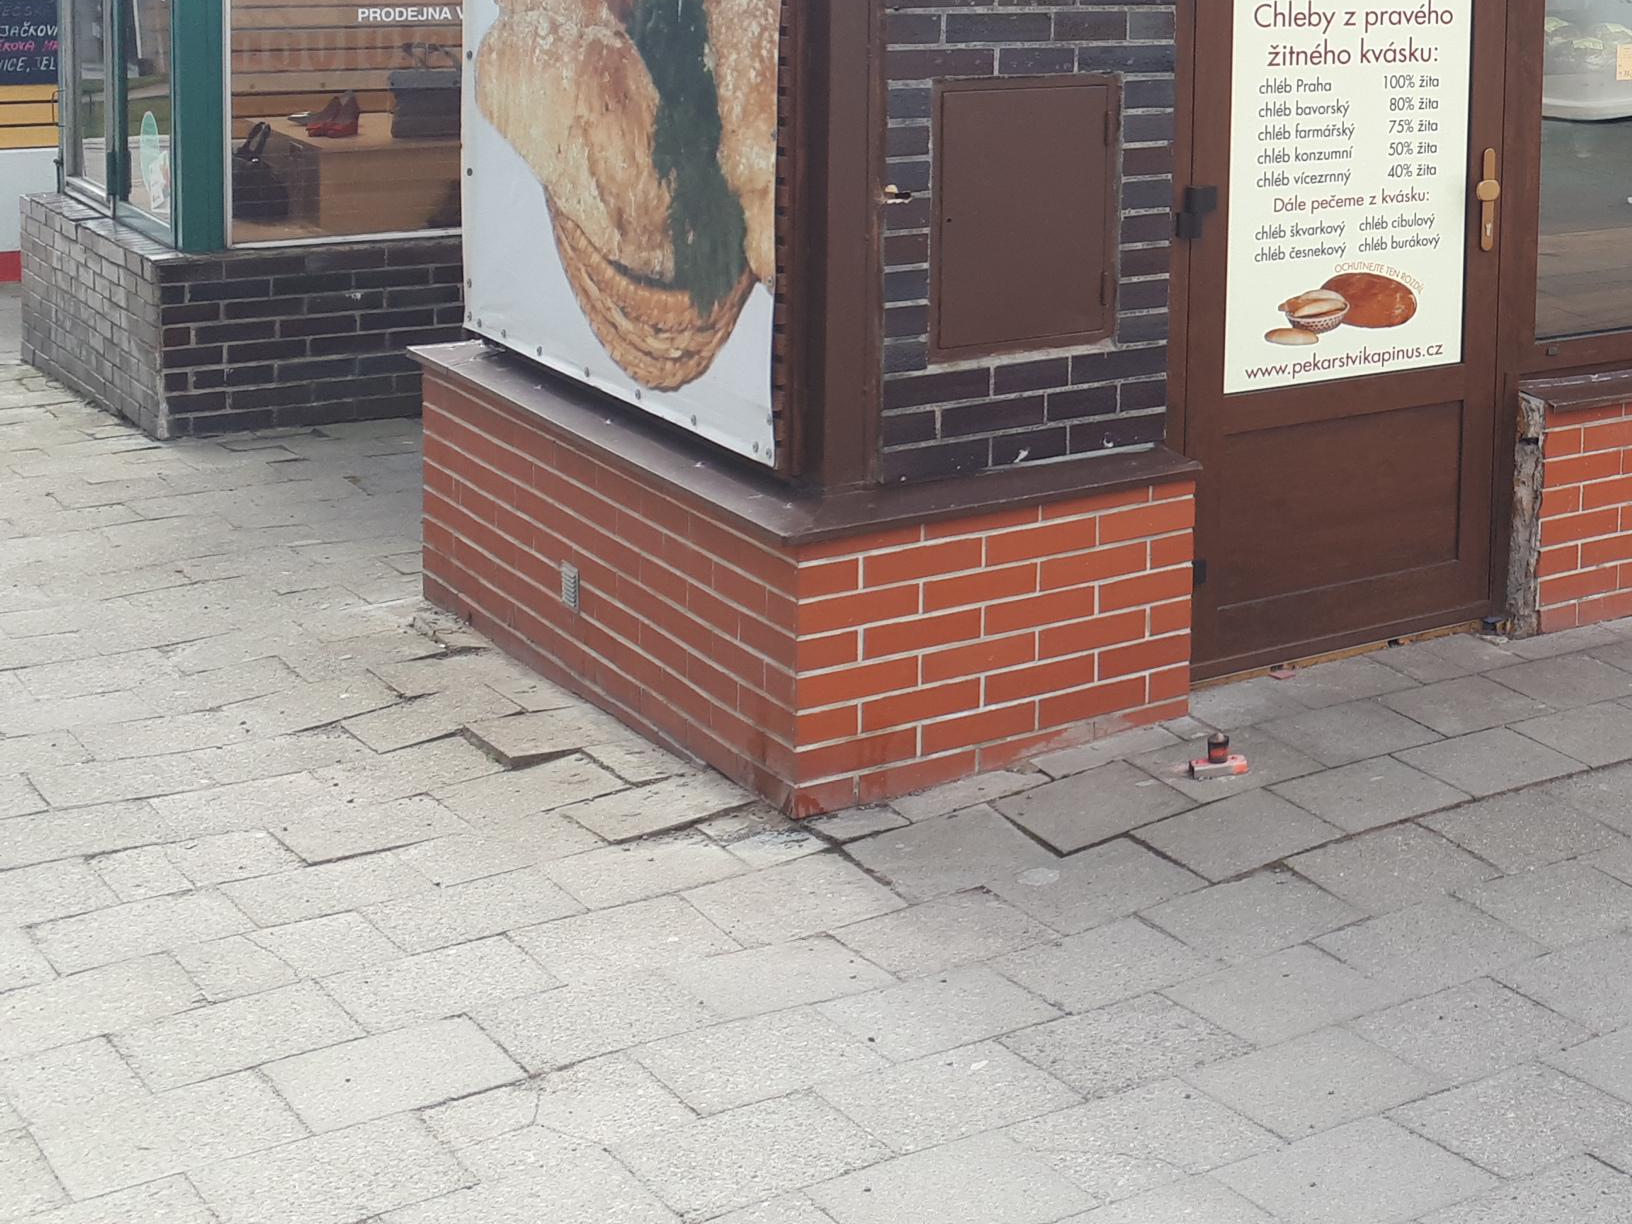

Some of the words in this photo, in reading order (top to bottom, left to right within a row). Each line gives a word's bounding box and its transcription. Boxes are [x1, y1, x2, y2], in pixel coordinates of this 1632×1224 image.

[358, 6, 452, 22] PRODEJNA
[1254, 0, 1336, 34] Chleby
[1344, 9, 1356, 26] z
[1365, 0, 1453, 33] pravého
[1267, 39, 1351, 67] žitného
[1360, 37, 1438, 64] kvásku:
[1259, 77, 1292, 94] chléb
[1296, 77, 1332, 93] Praha
[1383, 74, 1415, 88] 100%
[1419, 75, 1440, 87] žita
[1258, 100, 1292, 118] chléb
[1295, 98, 1350, 118] bavorský
[1389, 97, 1415, 111] 80%
[1418, 97, 1439, 110] žita
[1258, 124, 1291, 141] chléb
[1295, 121, 1355, 140] farmářský
[1388, 119, 1414, 133] 75%
[1418, 120, 1438, 132] žita
[1257, 147, 1290, 164] chléb
[1294, 146, 1354, 162] konzumní
[1388, 141, 1413, 156] 50%
[1417, 142, 1438, 155] žita
[1256, 170, 1290, 188] chléb
[1293, 168, 1351, 186] vícezrnný
[1387, 164, 1413, 178] 40%
[1416, 164, 1437, 177] žita
[1273, 195, 1306, 213] Dále
[1311, 194, 1364, 214] pečeme
[1369, 195, 1377, 206] z
[1381, 186, 1430, 204] kvásku:
[1255, 224, 1286, 241] chléb
[1290, 220, 1345, 238] škvarkový
[1359, 214, 1388, 232] chléb
[1391, 212, 1435, 229] cibulový
[1254, 245, 1285, 263] chléb
[1289, 241, 1346, 259] česnekový
[1358, 235, 1388, 252] chléb
[1334, 261, 1385, 273] OCHUTNEJTE
[1245, 342, 1443, 380] www.pekarstvikapinus.cz
